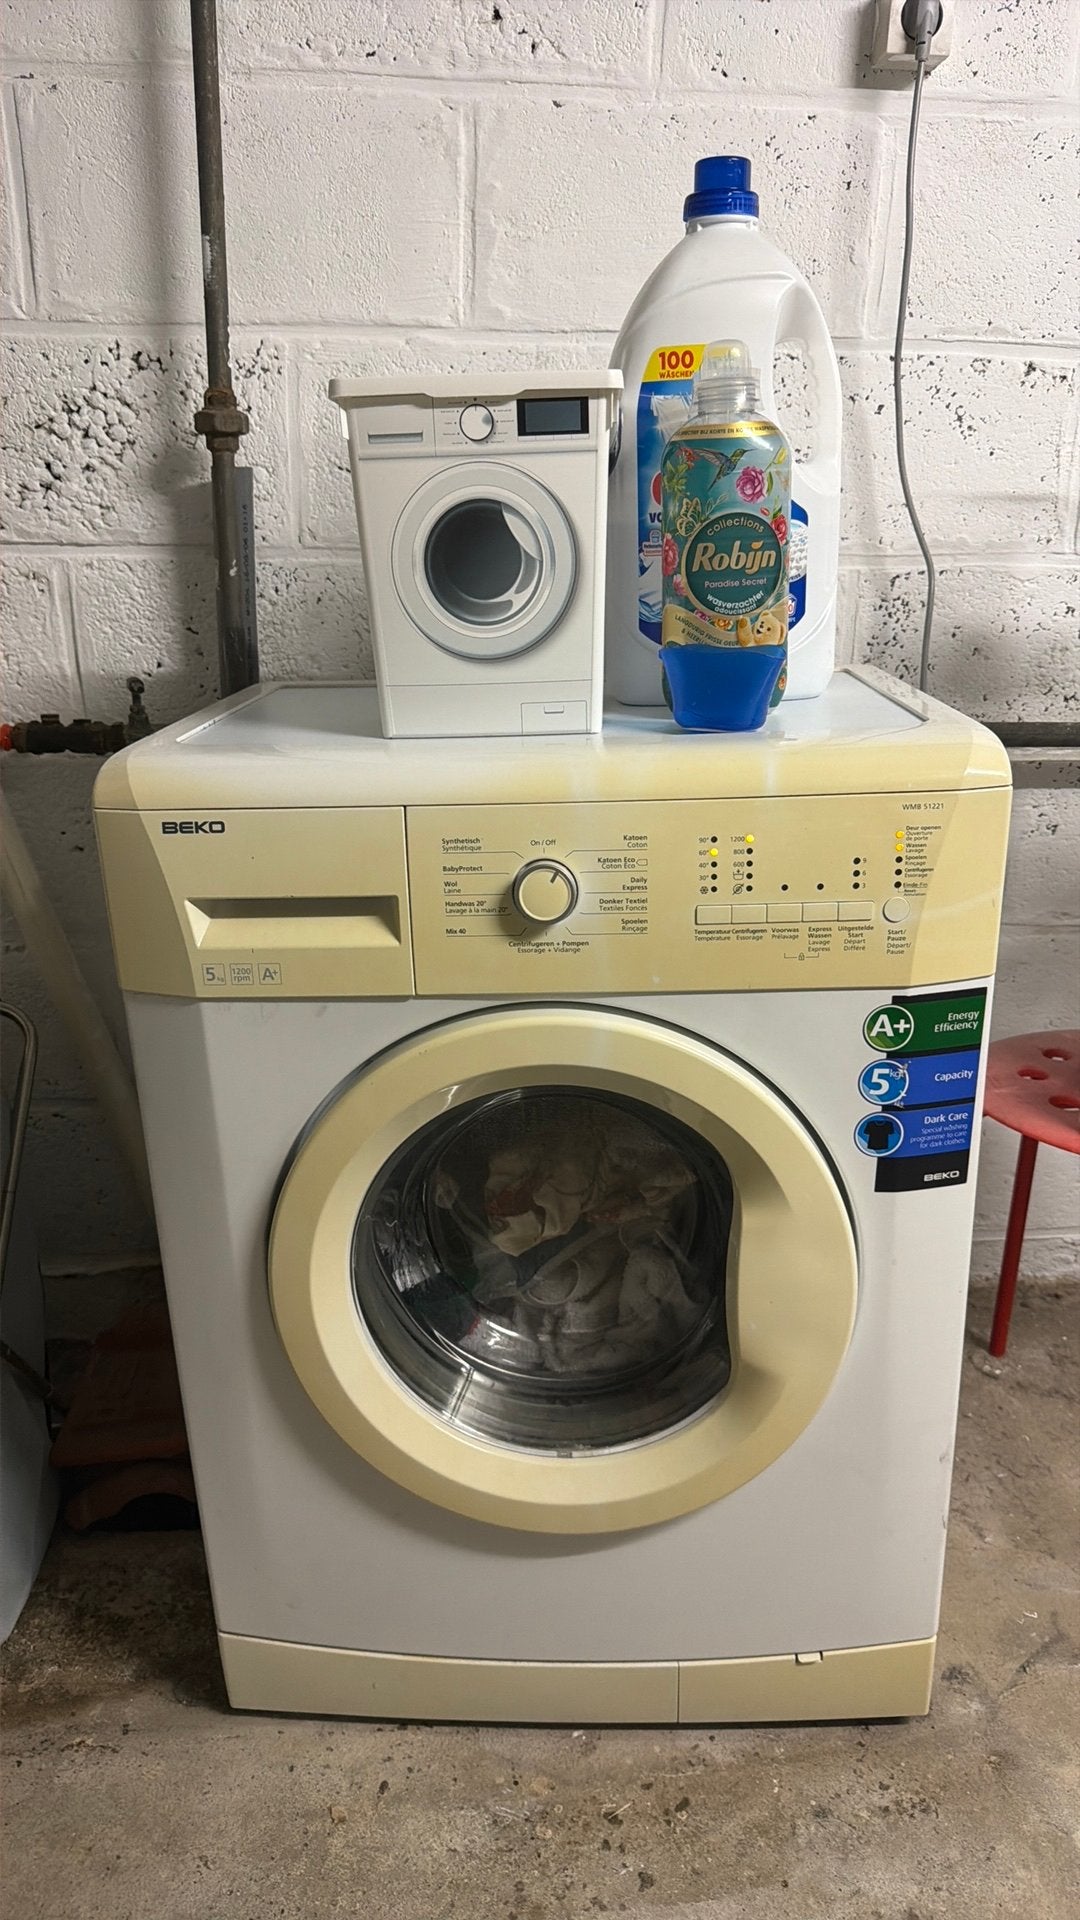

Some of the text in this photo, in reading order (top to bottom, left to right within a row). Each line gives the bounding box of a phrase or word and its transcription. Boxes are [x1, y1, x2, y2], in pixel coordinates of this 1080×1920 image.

[658, 350, 694, 370] 100
[707, 517, 764, 536] collections
[692, 540, 776, 575] Robijn
[707, 590, 764, 609] wasverzachter
[714, 604, 757, 615] adoucissant
[675, 614, 705, 635] LANGDURIG
[705, 633, 722, 645] FRISSE
[161, 821, 225, 834] BEKO
[206, 967, 215, 981] 5
[262, 968, 278, 980] A+
[948, 1011, 980, 1021] Energy
[870, 1014, 910, 1037] A+
[934, 1021, 978, 1032] Efficiency
[870, 1068, 890, 1095] 5
[934, 1070, 974, 1082] Capacity
[924, 1112, 968, 1124] Dark Care
[922, 1126, 942, 1134] Special
[910, 1134, 945, 1144] programme
[924, 1171, 959, 1181] BEKO
